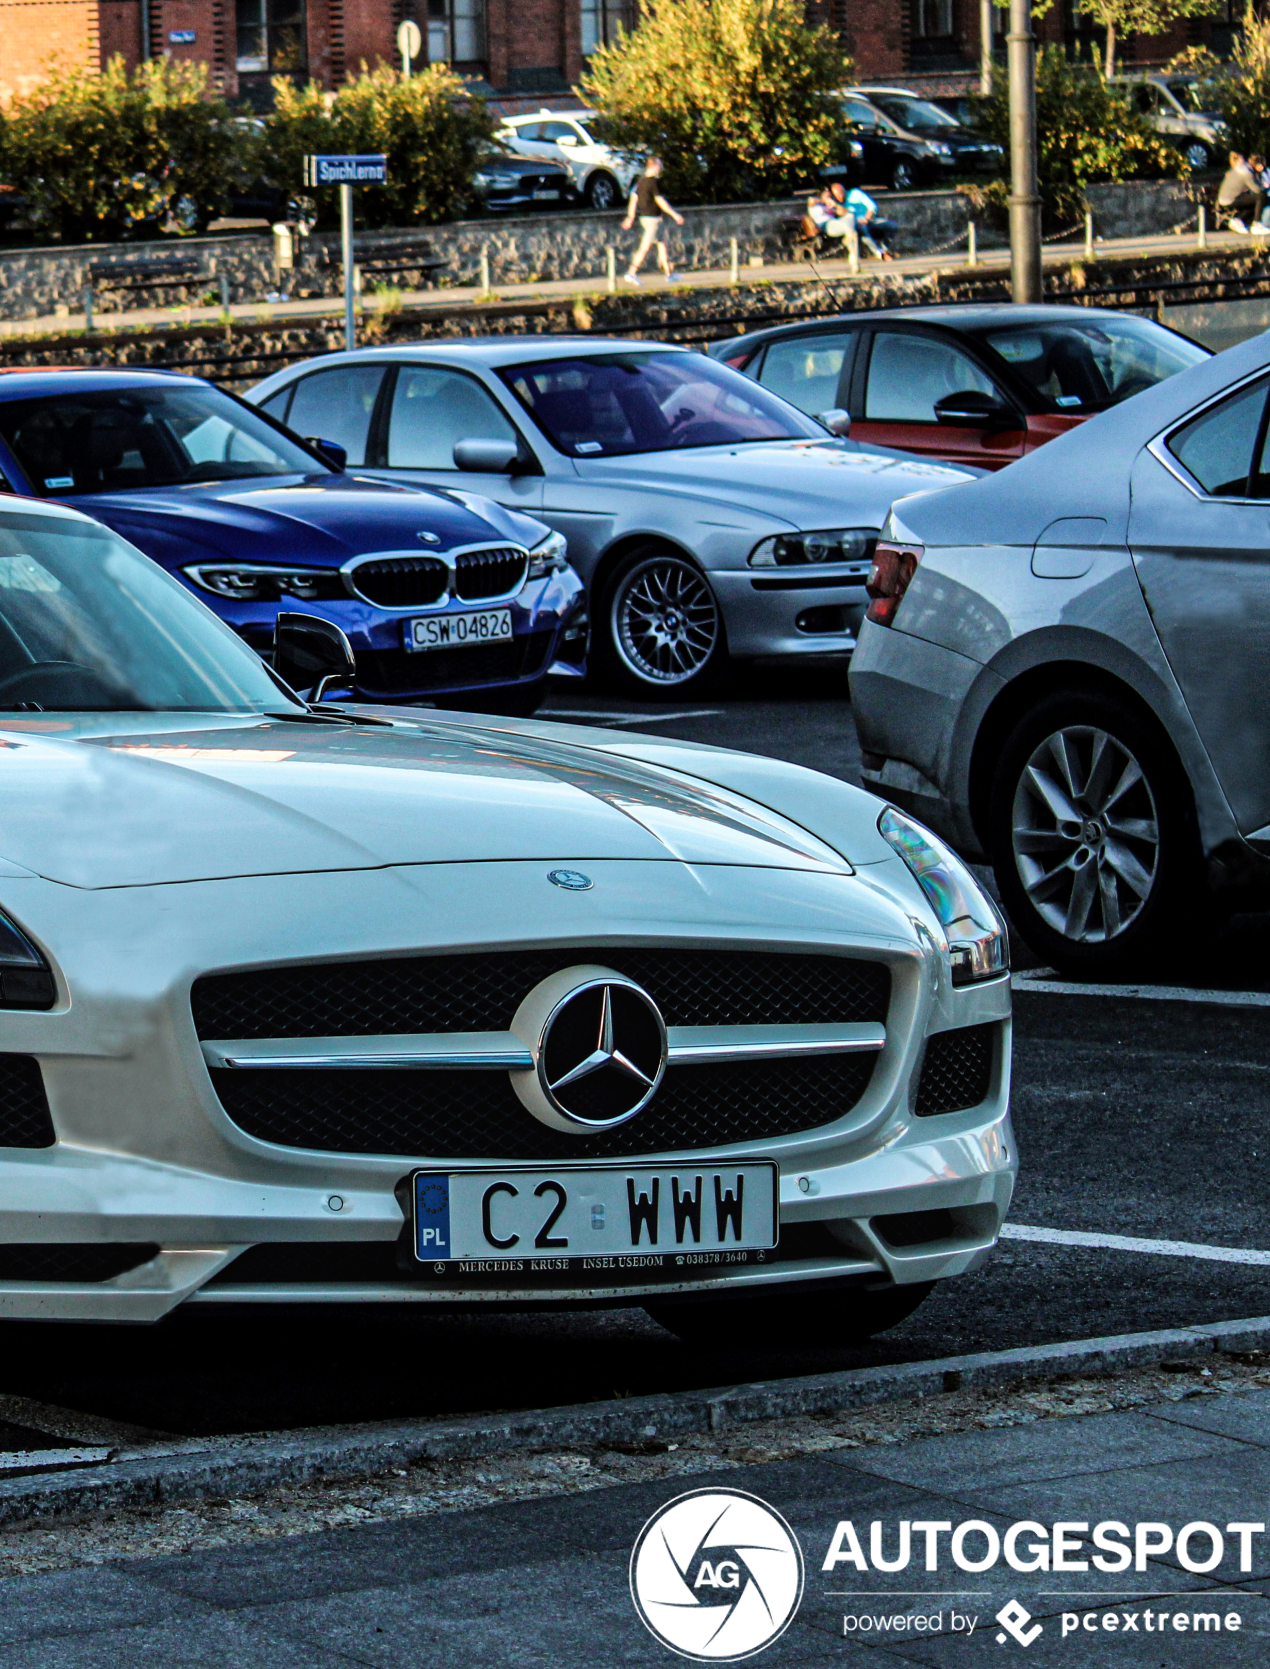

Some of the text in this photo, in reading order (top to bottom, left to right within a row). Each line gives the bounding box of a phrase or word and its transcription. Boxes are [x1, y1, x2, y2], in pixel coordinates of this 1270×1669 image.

[414, 612, 510, 645] CSW 04826
[481, 1173, 745, 1250] C2 WWW
[422, 1227, 446, 1246] PL
[458, 1252, 748, 1273] MERCEDES KRUSE INSEL USEDOM 038378/3640
